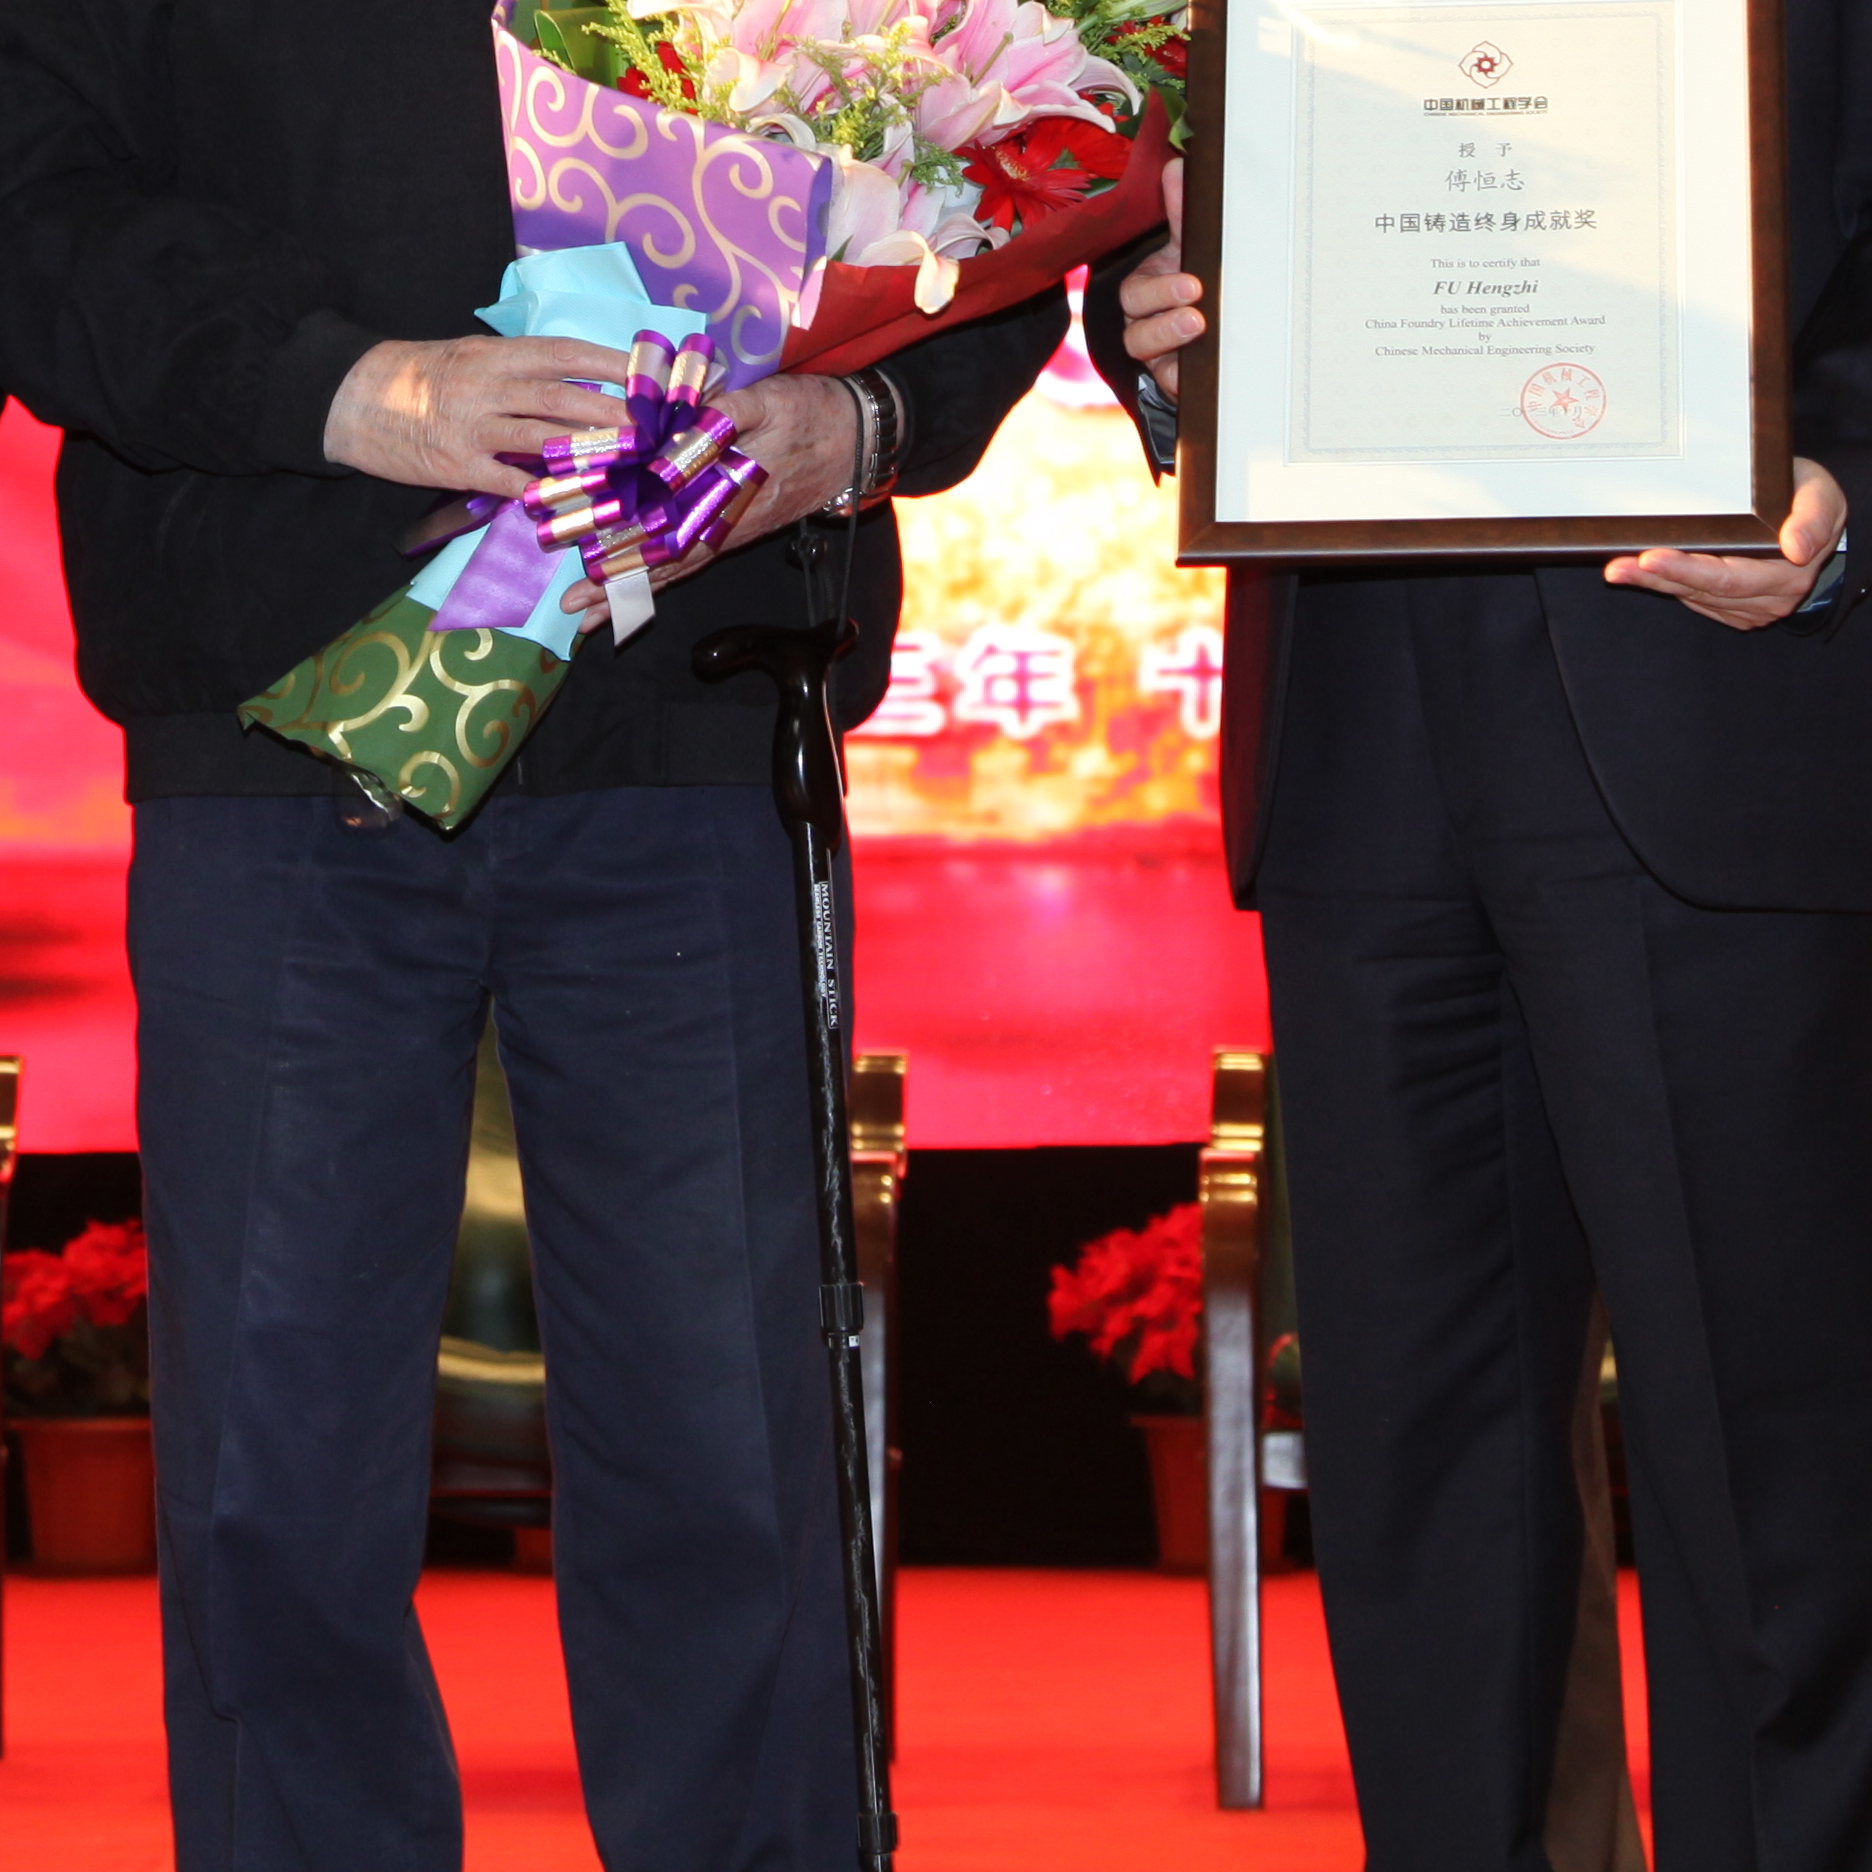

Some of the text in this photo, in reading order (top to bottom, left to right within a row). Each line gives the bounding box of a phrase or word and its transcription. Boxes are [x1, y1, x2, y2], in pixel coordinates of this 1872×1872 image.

[1445, 168, 1525, 193] 傅恒志
[1375, 208, 1598, 233] 中国铸造终身成就奖
[1430, 257, 1540, 270] This is to certify that
[1433, 279, 1539, 298] FU Hengzhi
[1440, 303, 1530, 316] has been granted
[1365, 315, 1606, 331] China Foundry Lifetime Achievement Award
[1478, 331, 1492, 343] by
[1375, 343, 1596, 357] Chinese Mechanical Engineering Society
[820, 882, 839, 1026] MOUNTAIN STICK
